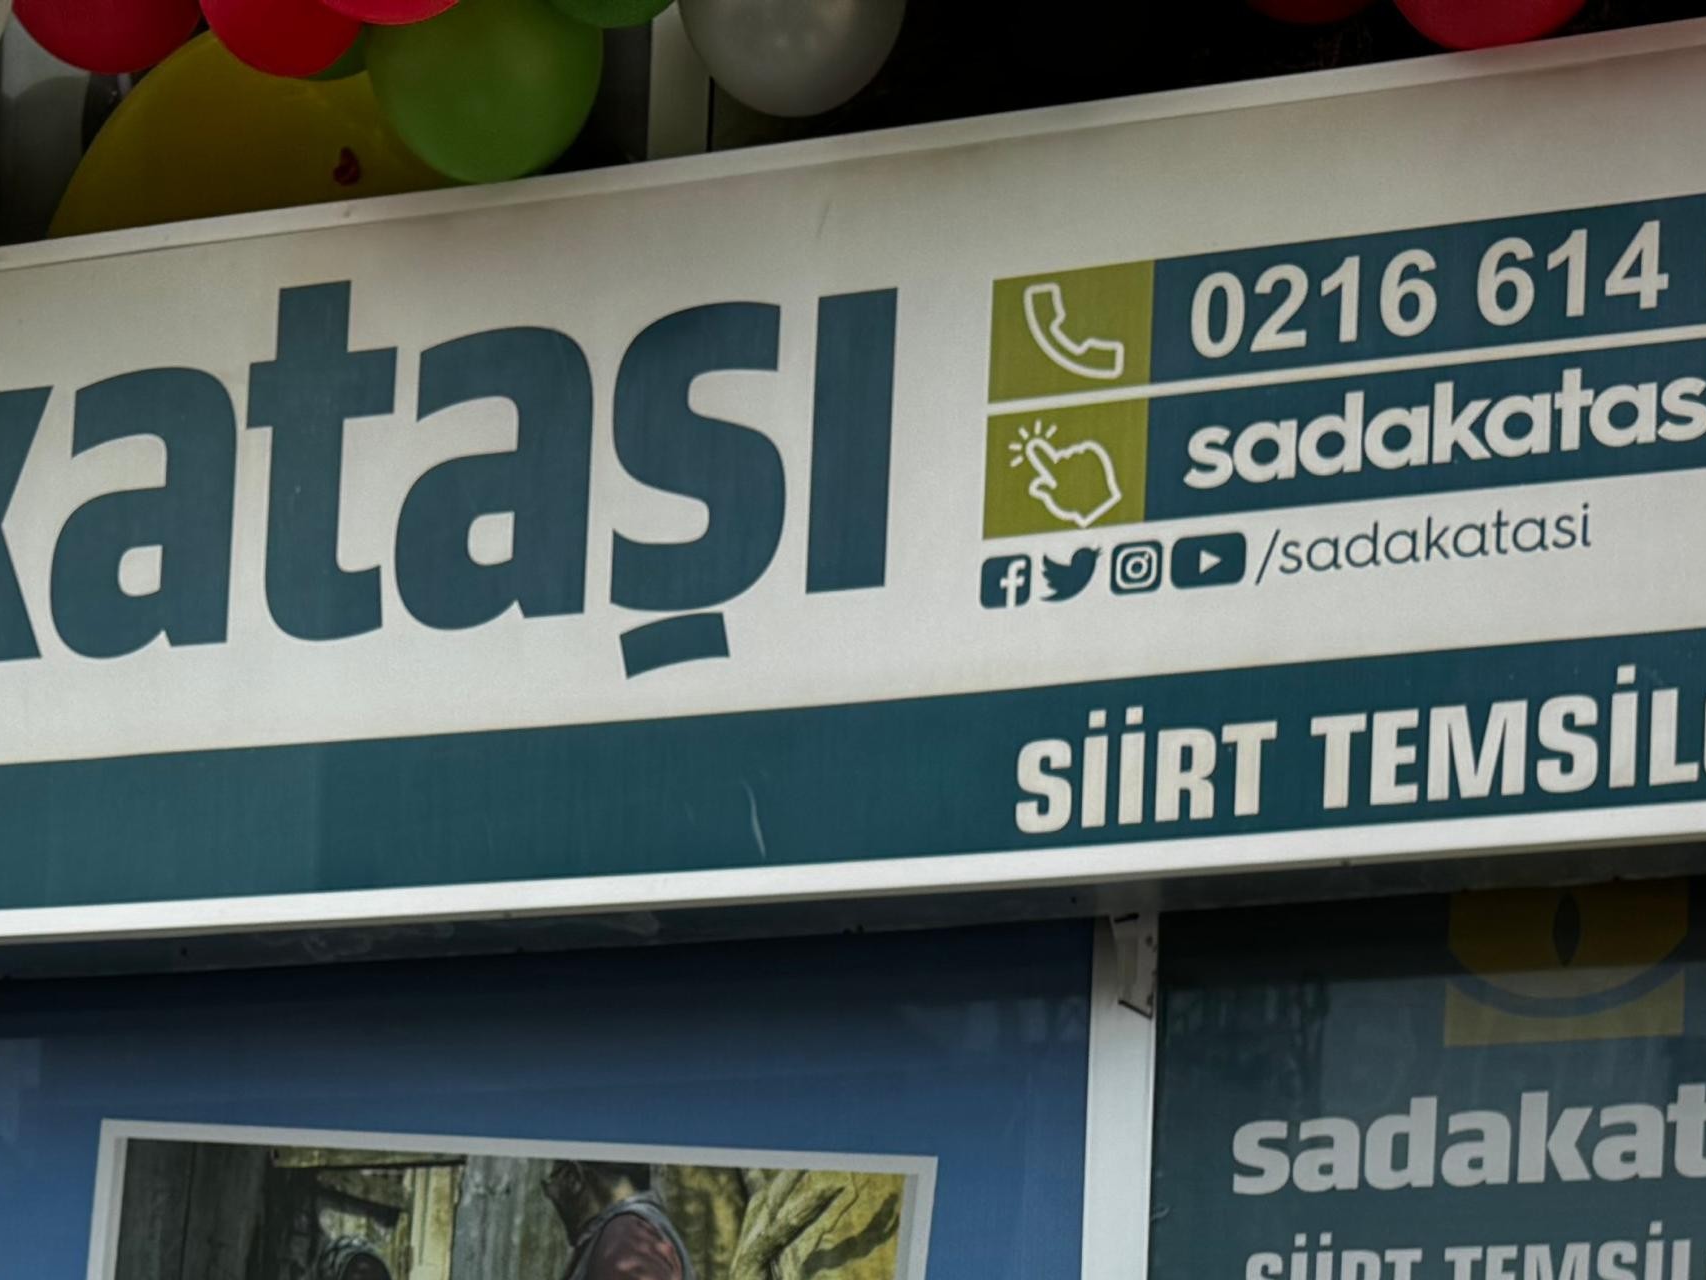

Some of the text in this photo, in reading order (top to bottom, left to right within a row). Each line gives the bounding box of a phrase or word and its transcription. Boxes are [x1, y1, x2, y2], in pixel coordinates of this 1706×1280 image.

[1189, 247, 1440, 360] 0216
[1475, 219, 1671, 327] 614
[1014, 704, 1278, 835] SİİRT
